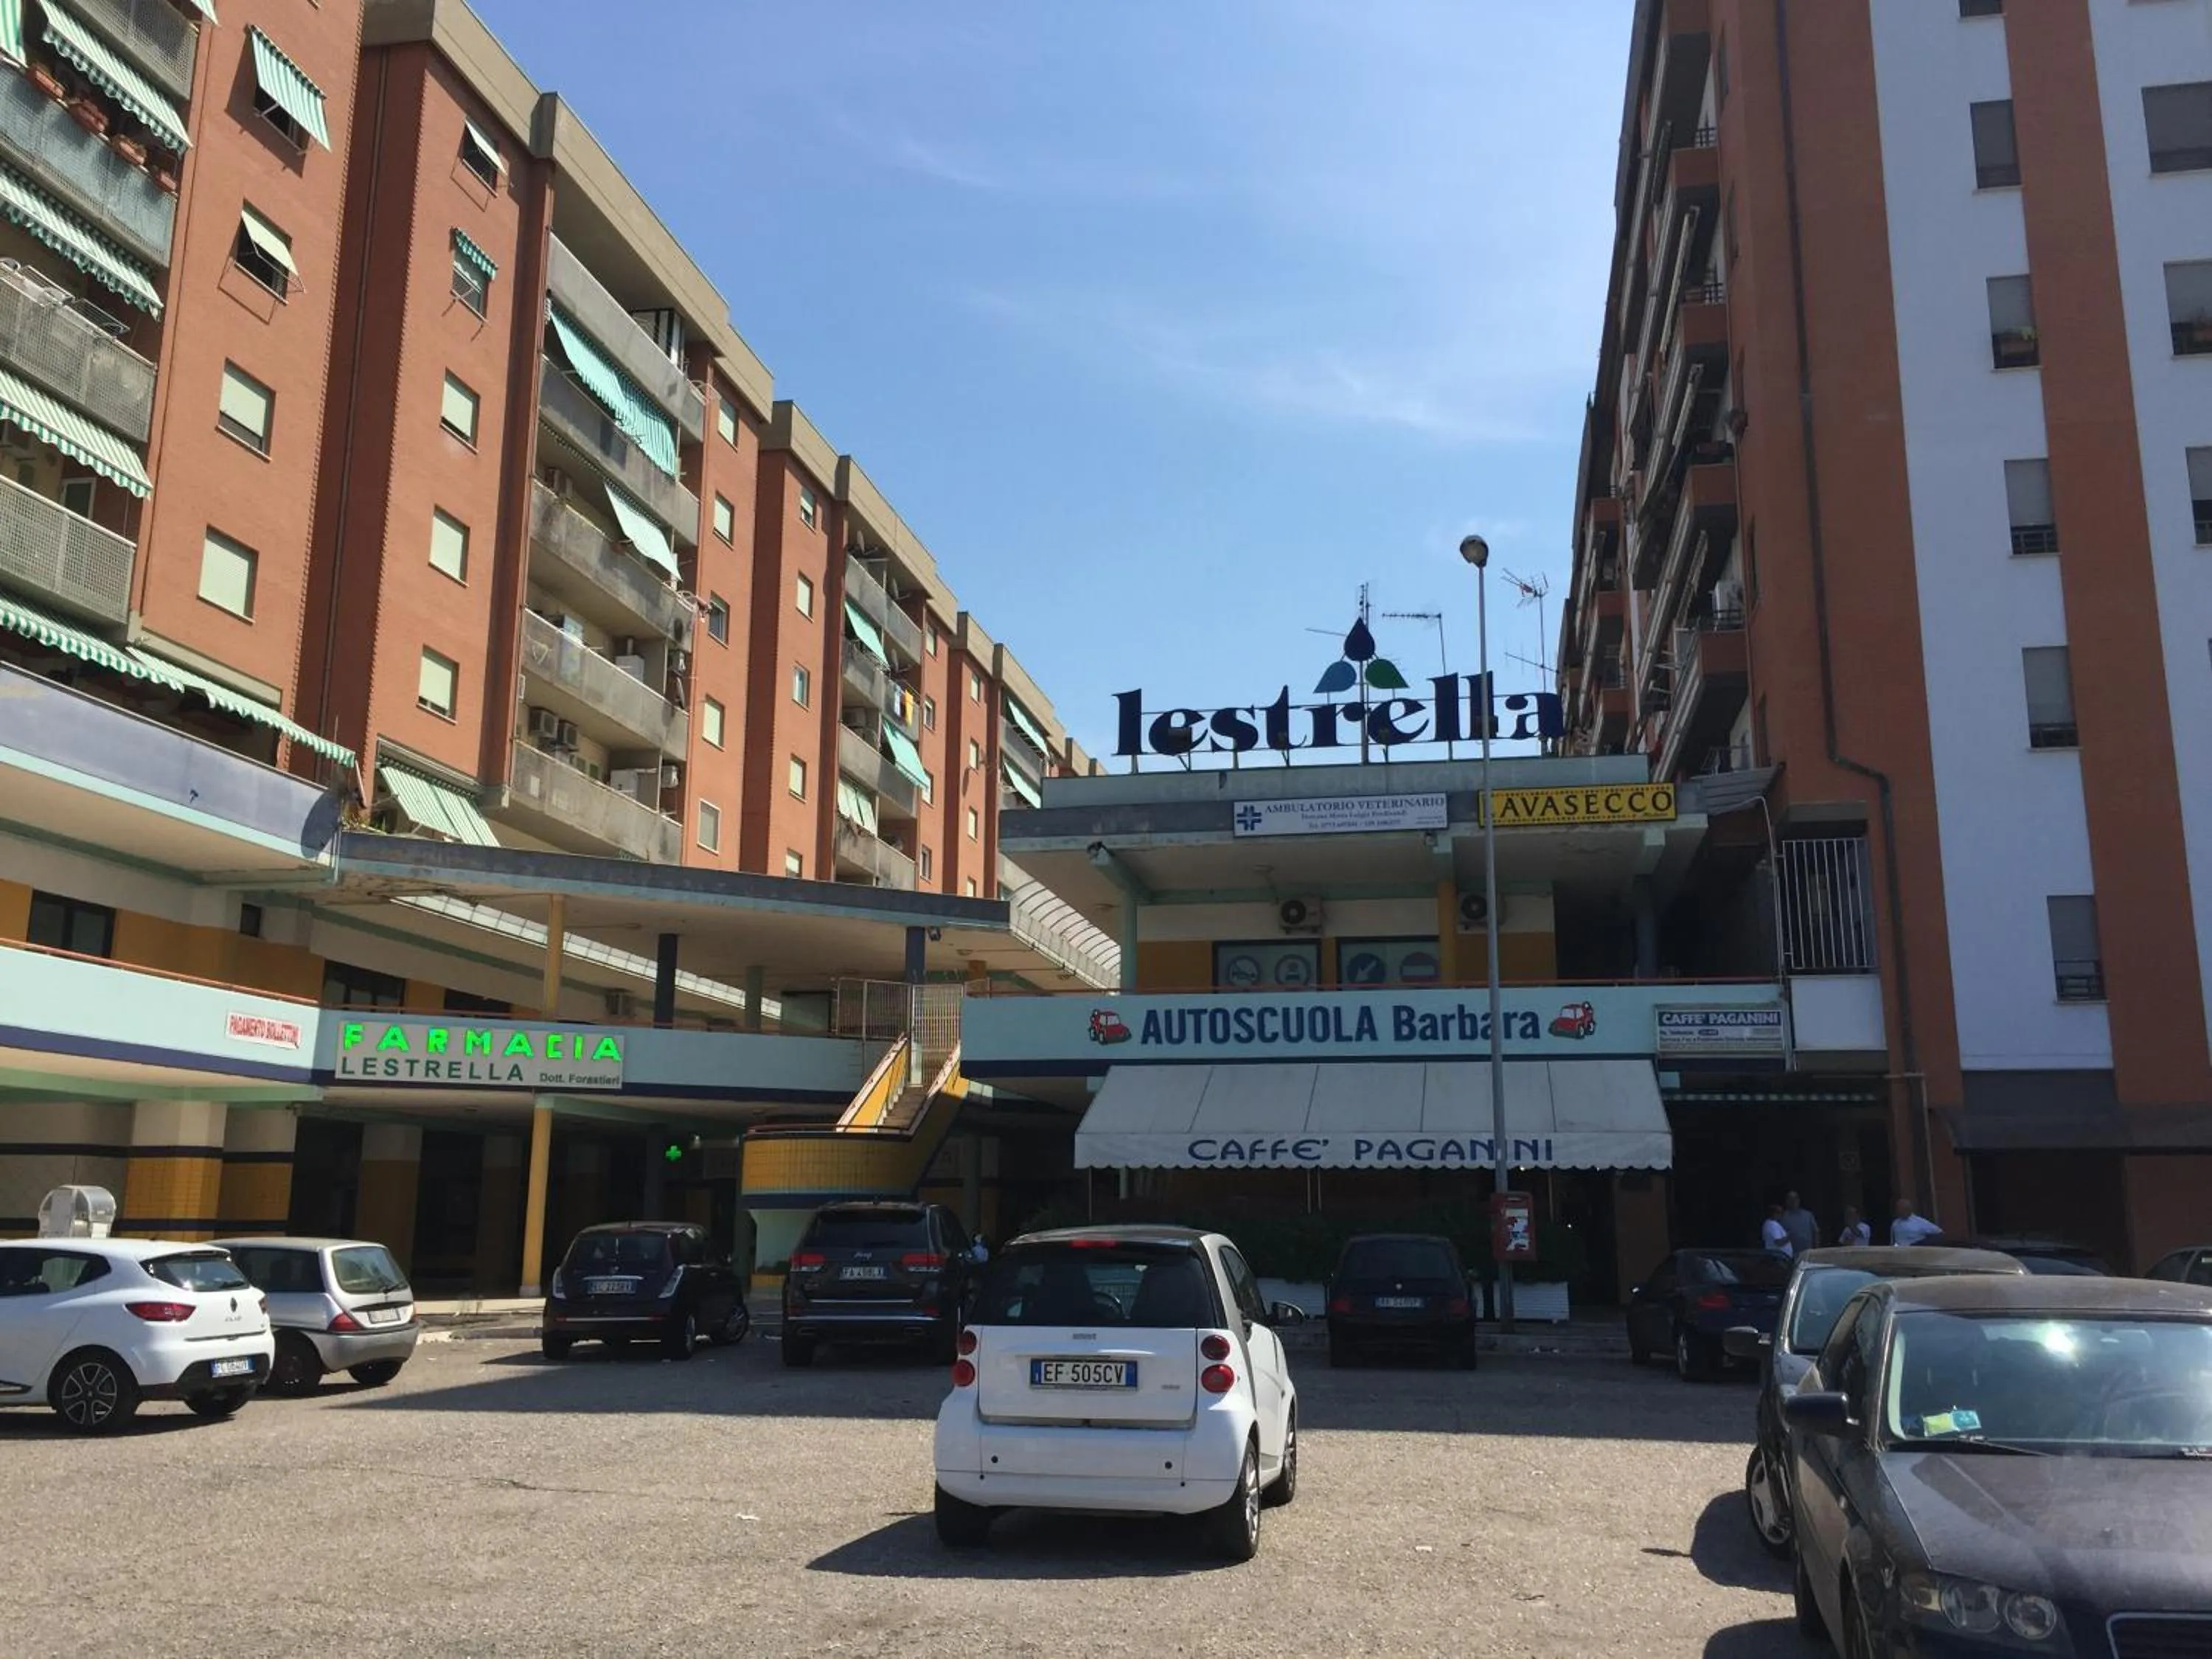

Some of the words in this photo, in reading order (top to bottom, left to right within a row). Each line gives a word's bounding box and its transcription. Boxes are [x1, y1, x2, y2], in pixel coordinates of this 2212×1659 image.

[1111, 671, 1568, 757] lestrella
[1265, 801, 1354, 813] AMBULATORIO
[1357, 796, 1444, 810] VETERINARIO
[1484, 791, 1672, 818] AVASECCO
[1141, 1005, 1378, 1045] AUTOSCUOLA
[1393, 1004, 1540, 1042] Barbara
[1708, 1012, 1778, 1025] PAGANINI
[344, 1023, 622, 1062] FARMACIA
[341, 1057, 524, 1082] LESTRELLA
[568, 1073, 620, 1085] Forestieri
[1188, 1139, 1329, 1161] CAFFE'
[1354, 1139, 1552, 1161] PAGANNI
[1044, 1364, 1063, 1382] EF
[1071, 1364, 1124, 1382] 505CV
